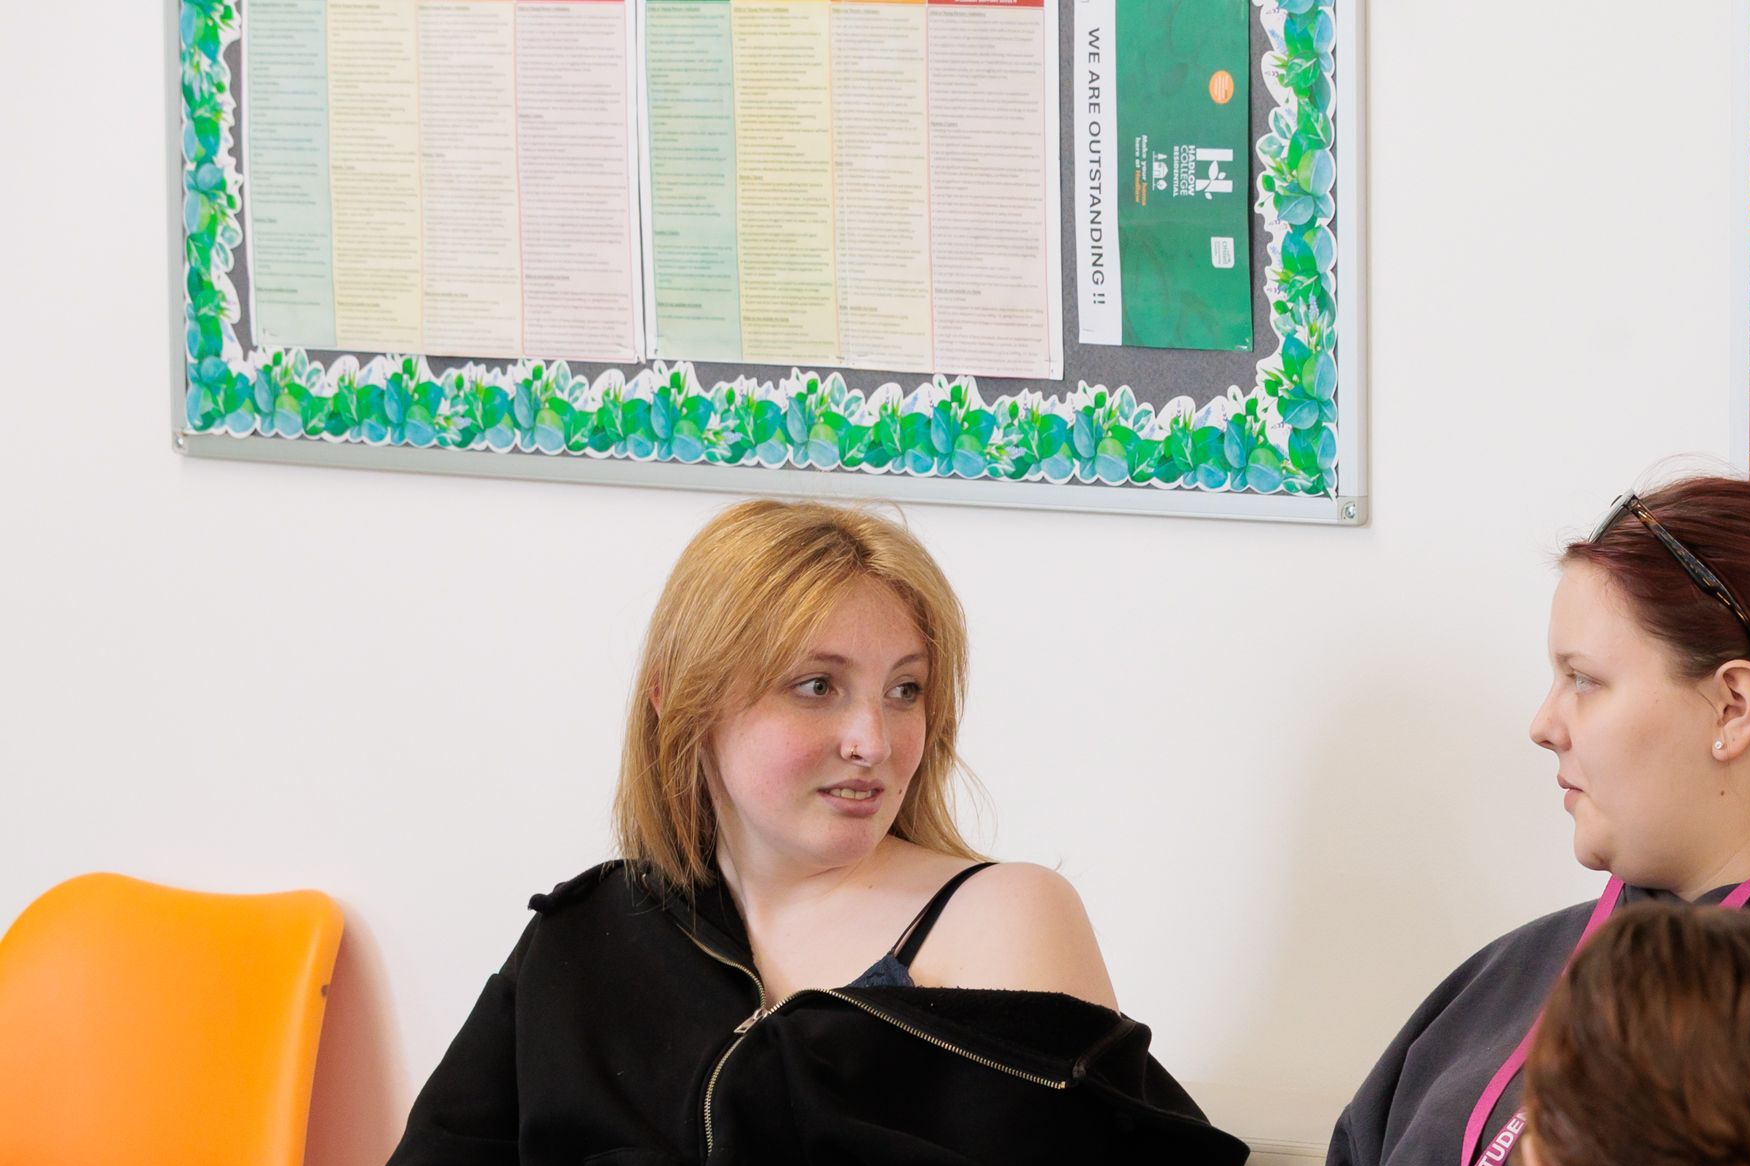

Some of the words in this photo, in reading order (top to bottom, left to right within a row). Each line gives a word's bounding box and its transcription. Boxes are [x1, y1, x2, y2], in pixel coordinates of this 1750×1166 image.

[1088, 27, 1100, 64] WE
[1088, 70, 1101, 114] ARE
[1172, 146, 1180, 197] RESIDENTIAL
[1180, 145, 1188, 196] COLLEGE
[1188, 145, 1196, 196] HADLOW
[1088, 120, 1105, 286] OUTSTANDING
